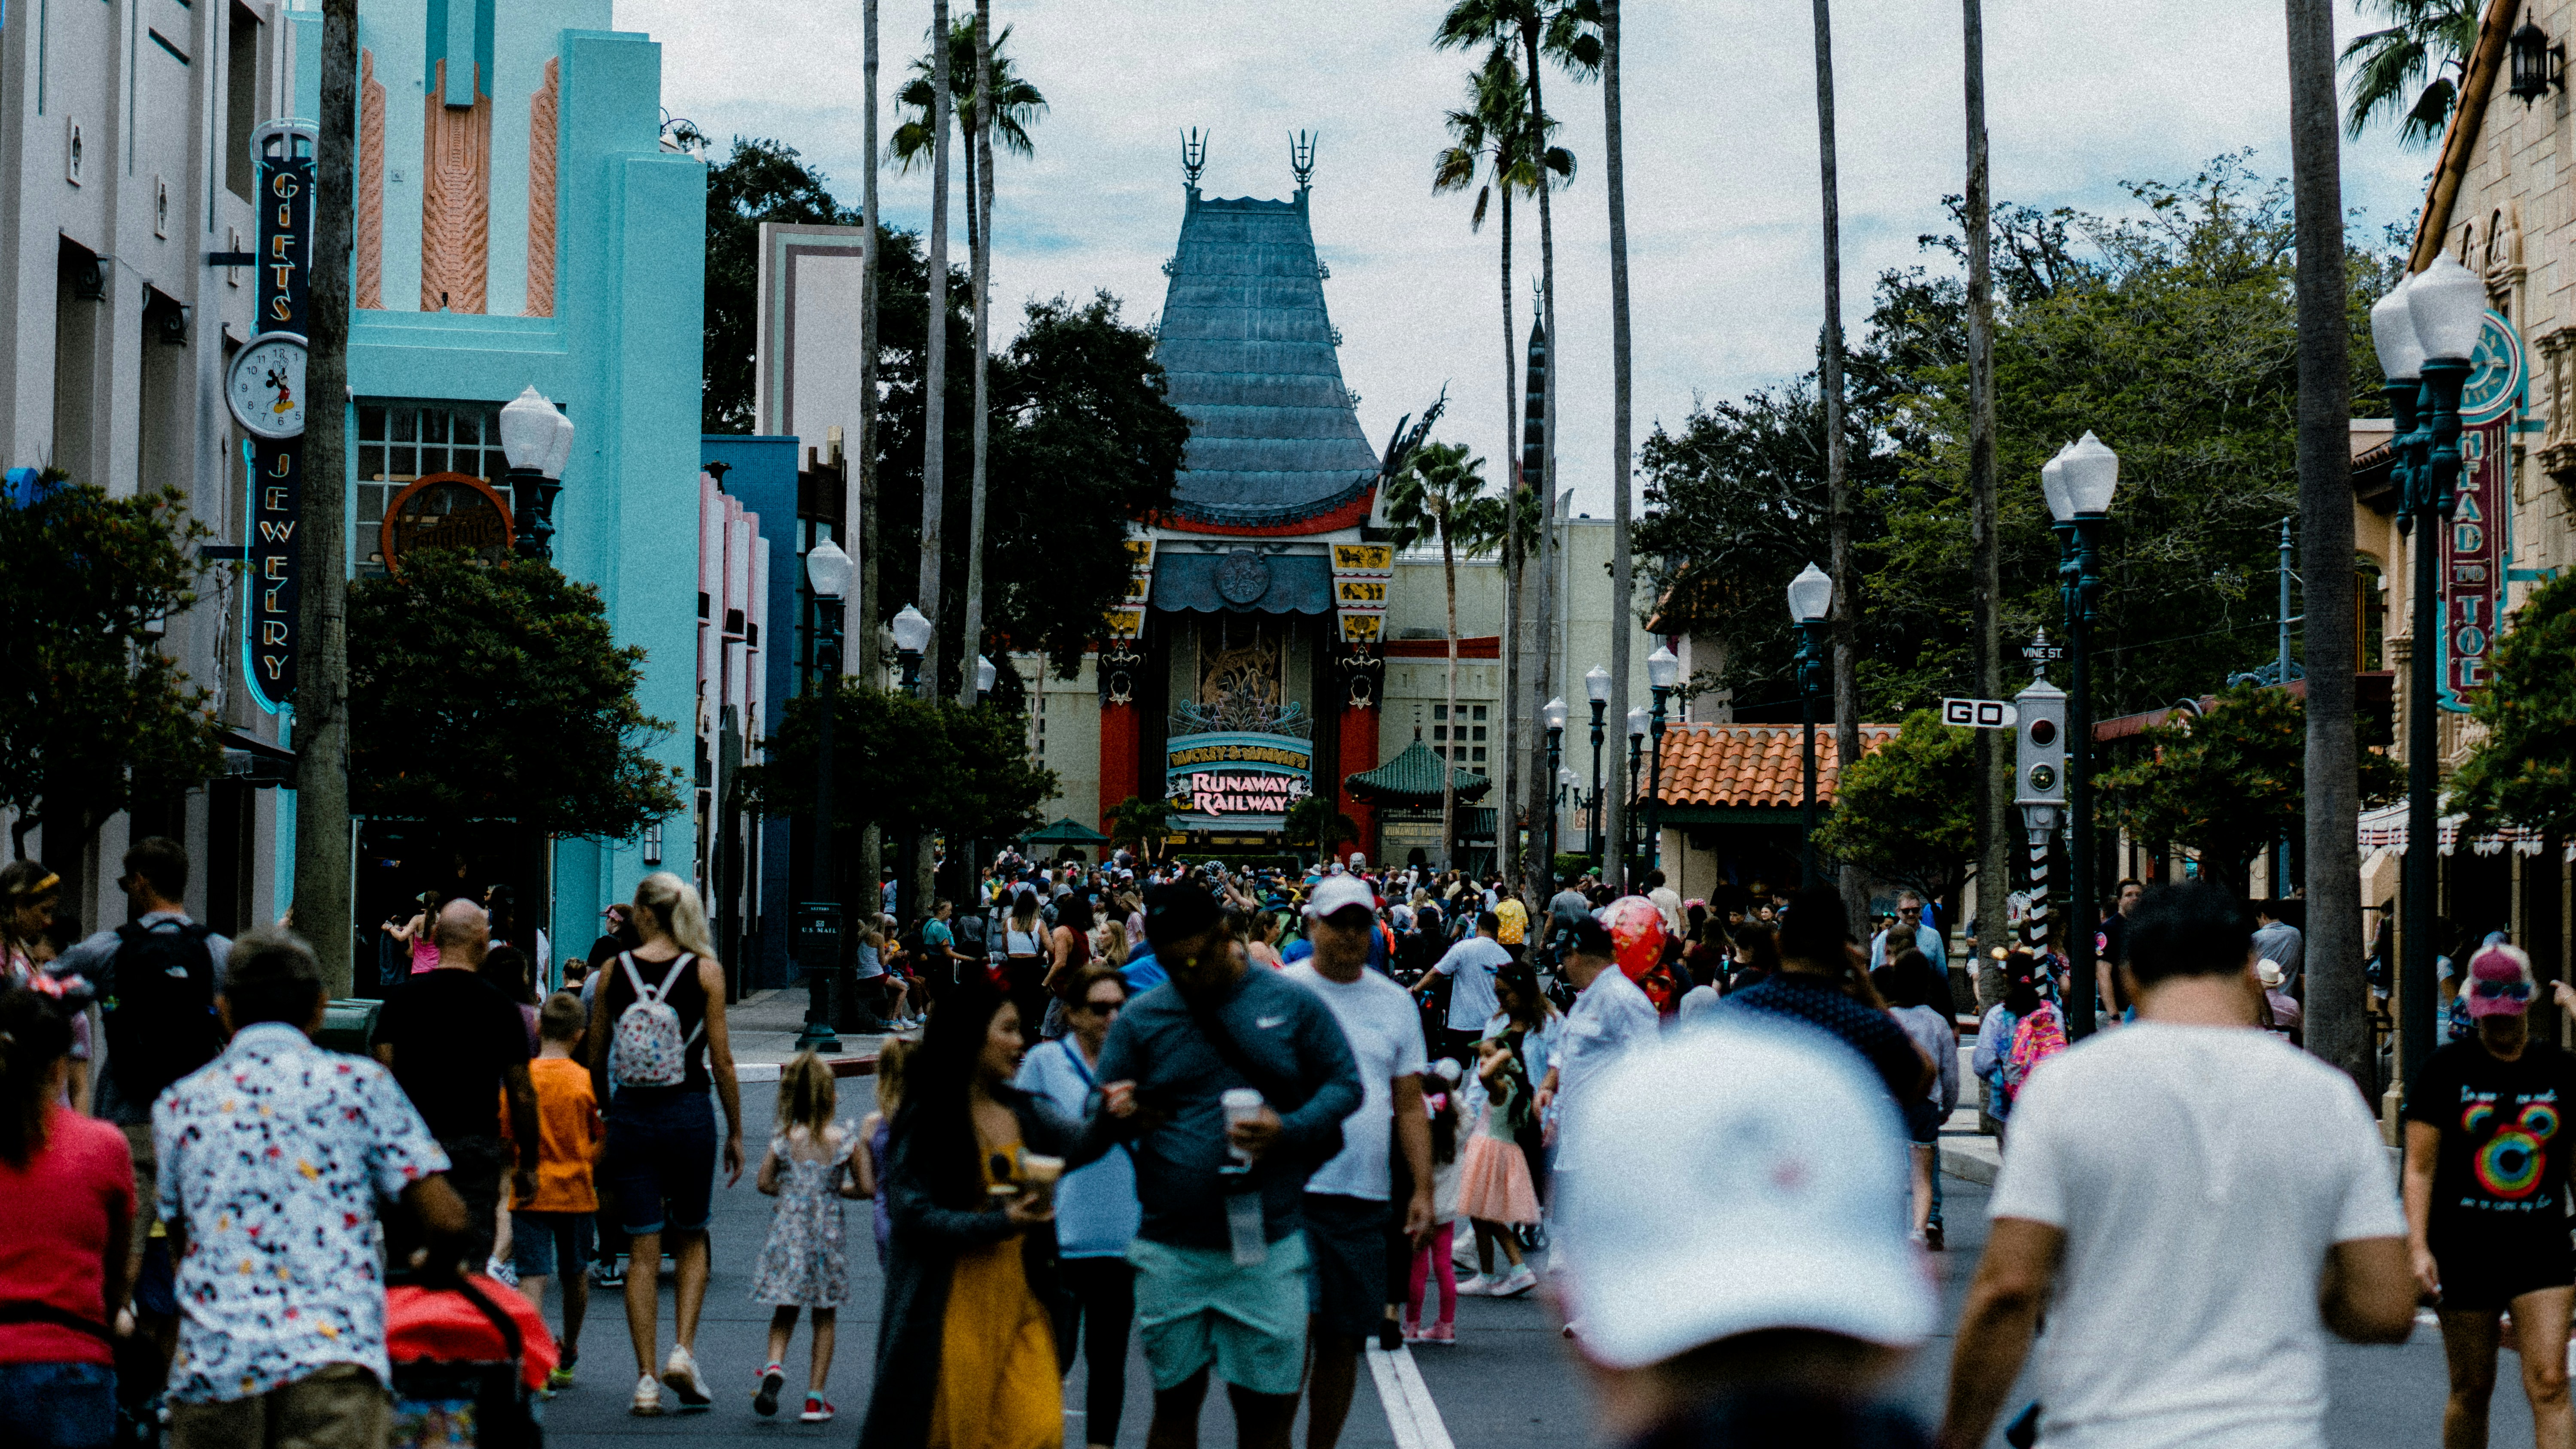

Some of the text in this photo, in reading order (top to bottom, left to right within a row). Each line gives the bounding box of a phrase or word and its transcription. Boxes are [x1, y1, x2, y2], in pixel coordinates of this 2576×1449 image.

[270, 173, 299, 322] GIFTS
[273, 348, 285, 358] 12
[257, 355, 266, 364] 11
[246, 366, 258, 375] 10
[241, 383, 248, 392] 9
[247, 401, 254, 410] 8
[261, 412, 267, 421] 7
[295, 411, 301, 420] 5
[278, 417, 284, 426] 6
[259, 453, 296, 680] JEWELRY
[2453, 565, 2485, 582] TO
[2456, 595, 2485, 686] TOE
[2022, 647, 2063, 658] VINE ST.
[1947, 701, 2003, 725] GO
[1170, 746, 1308, 768] MICKEY & MINNIE'S
[1192, 773, 1291, 792] RUNAWAY
[1194, 792, 1288, 816] RAILWAY
[1385, 826, 1443, 836] RUNAWAY RAILW
